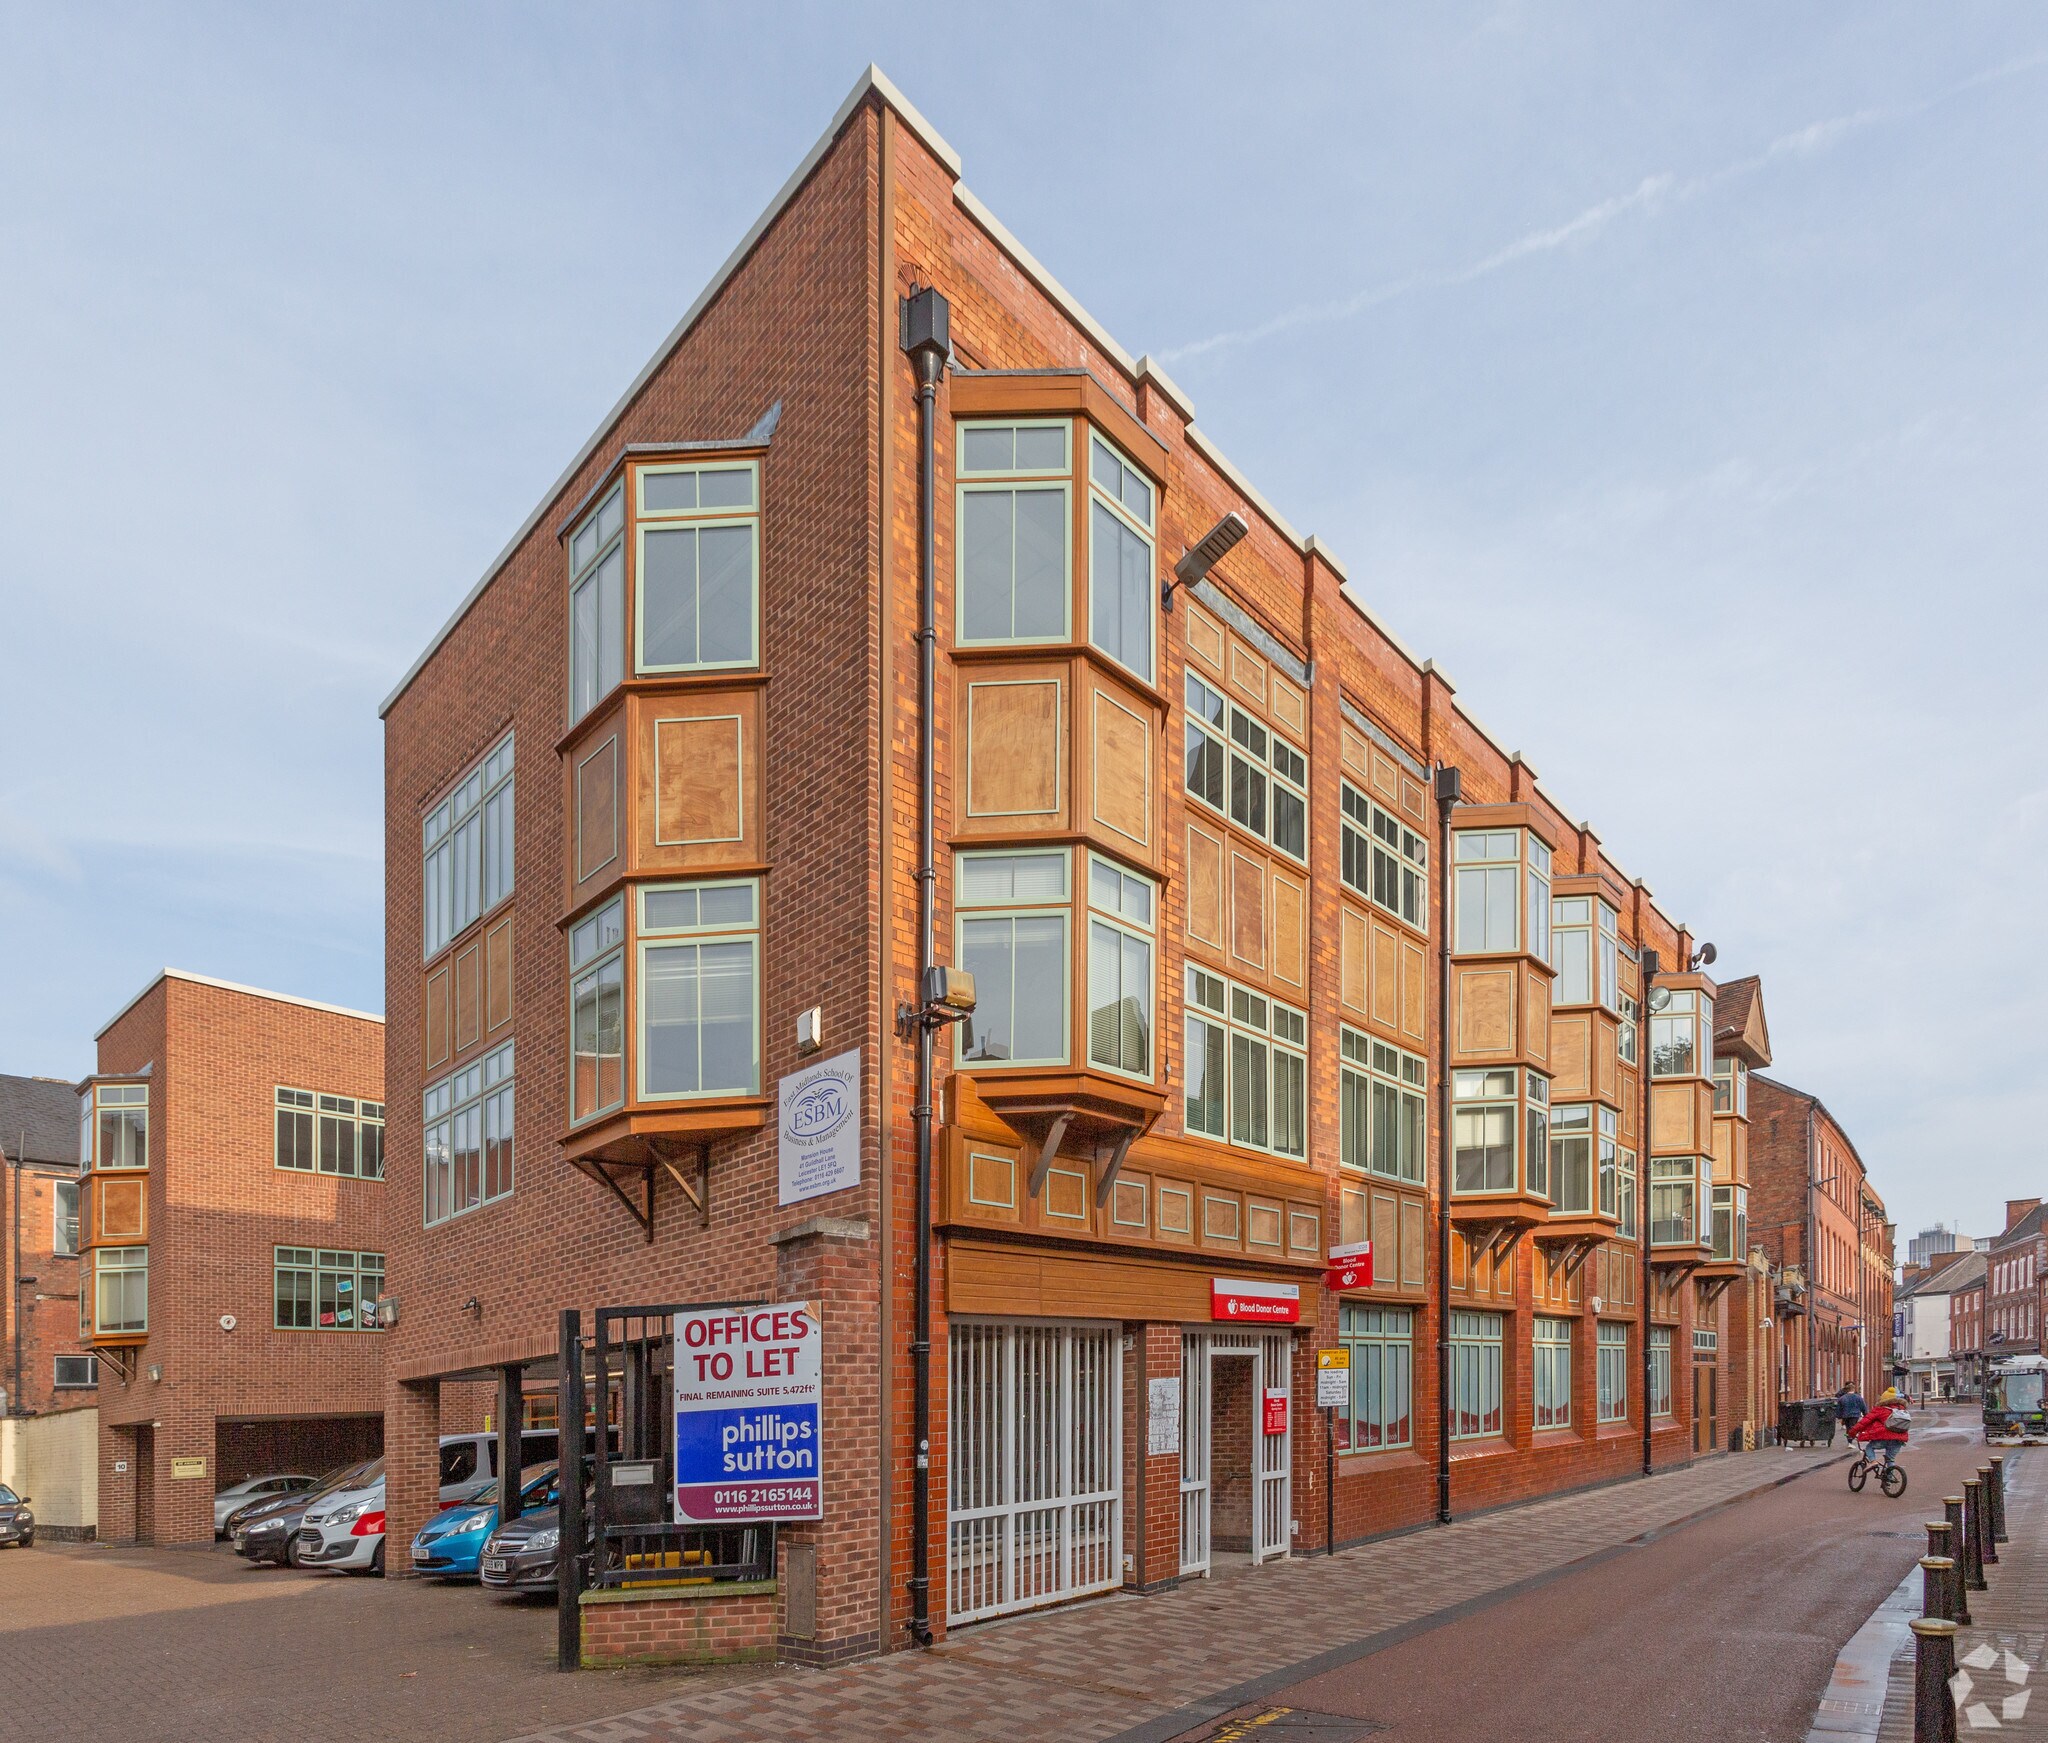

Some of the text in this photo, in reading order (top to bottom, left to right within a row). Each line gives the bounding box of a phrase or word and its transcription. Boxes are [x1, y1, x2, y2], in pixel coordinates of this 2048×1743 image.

[784, 1068, 855, 1107] East Midlands School Of
[794, 1096, 842, 1130] ESBM
[783, 1110, 854, 1147] Business & Management
[800, 1146, 834, 1161] Mansion House
[805, 1157, 824, 1168] Guildhall
[824, 1154, 836, 1162] Lane
[798, 1167, 818, 1178] Leicester
[1240, 1303, 1289, 1314] Blood Donor Centre
[685, 1310, 808, 1348] OFFICES
[693, 1347, 800, 1382] TO LET
[680, 1392, 703, 1401] FINAL
[706, 1388, 754, 1400] REMAINING
[757, 1386, 780, 1397] SUITE
[722, 1414, 812, 1452] phillips
[723, 1444, 812, 1472] sutton
[714, 1487, 812, 1504] 0116 2165144
[715, 1502, 812, 1514] www.phillipssutton.co.uk
